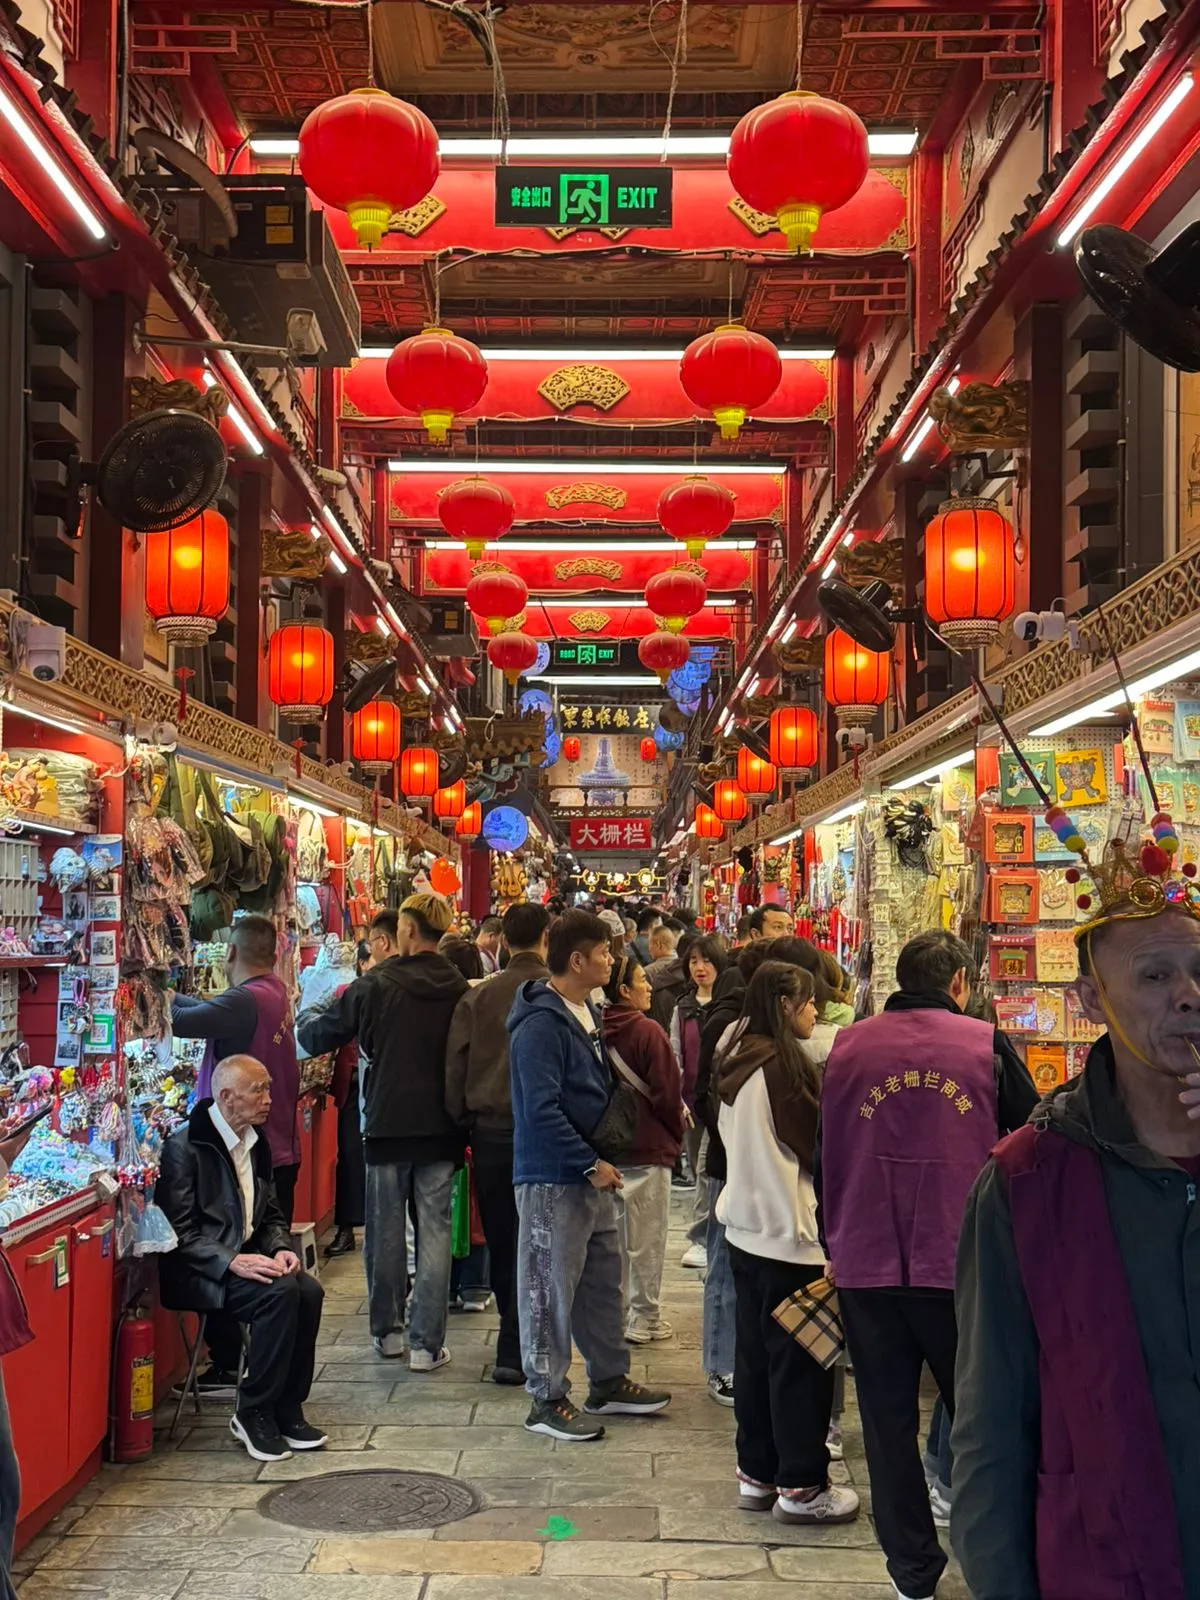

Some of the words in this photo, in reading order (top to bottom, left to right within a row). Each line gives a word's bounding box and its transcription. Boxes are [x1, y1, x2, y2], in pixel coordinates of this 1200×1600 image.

[511, 187, 551, 208] 安全出口
[617, 187, 658, 208] EXIT
[598, 649, 614, 659] EXIT
[576, 823, 647, 845] 大栅栏
[859, 1069, 974, 1120] 吉龙老栅栏商城
